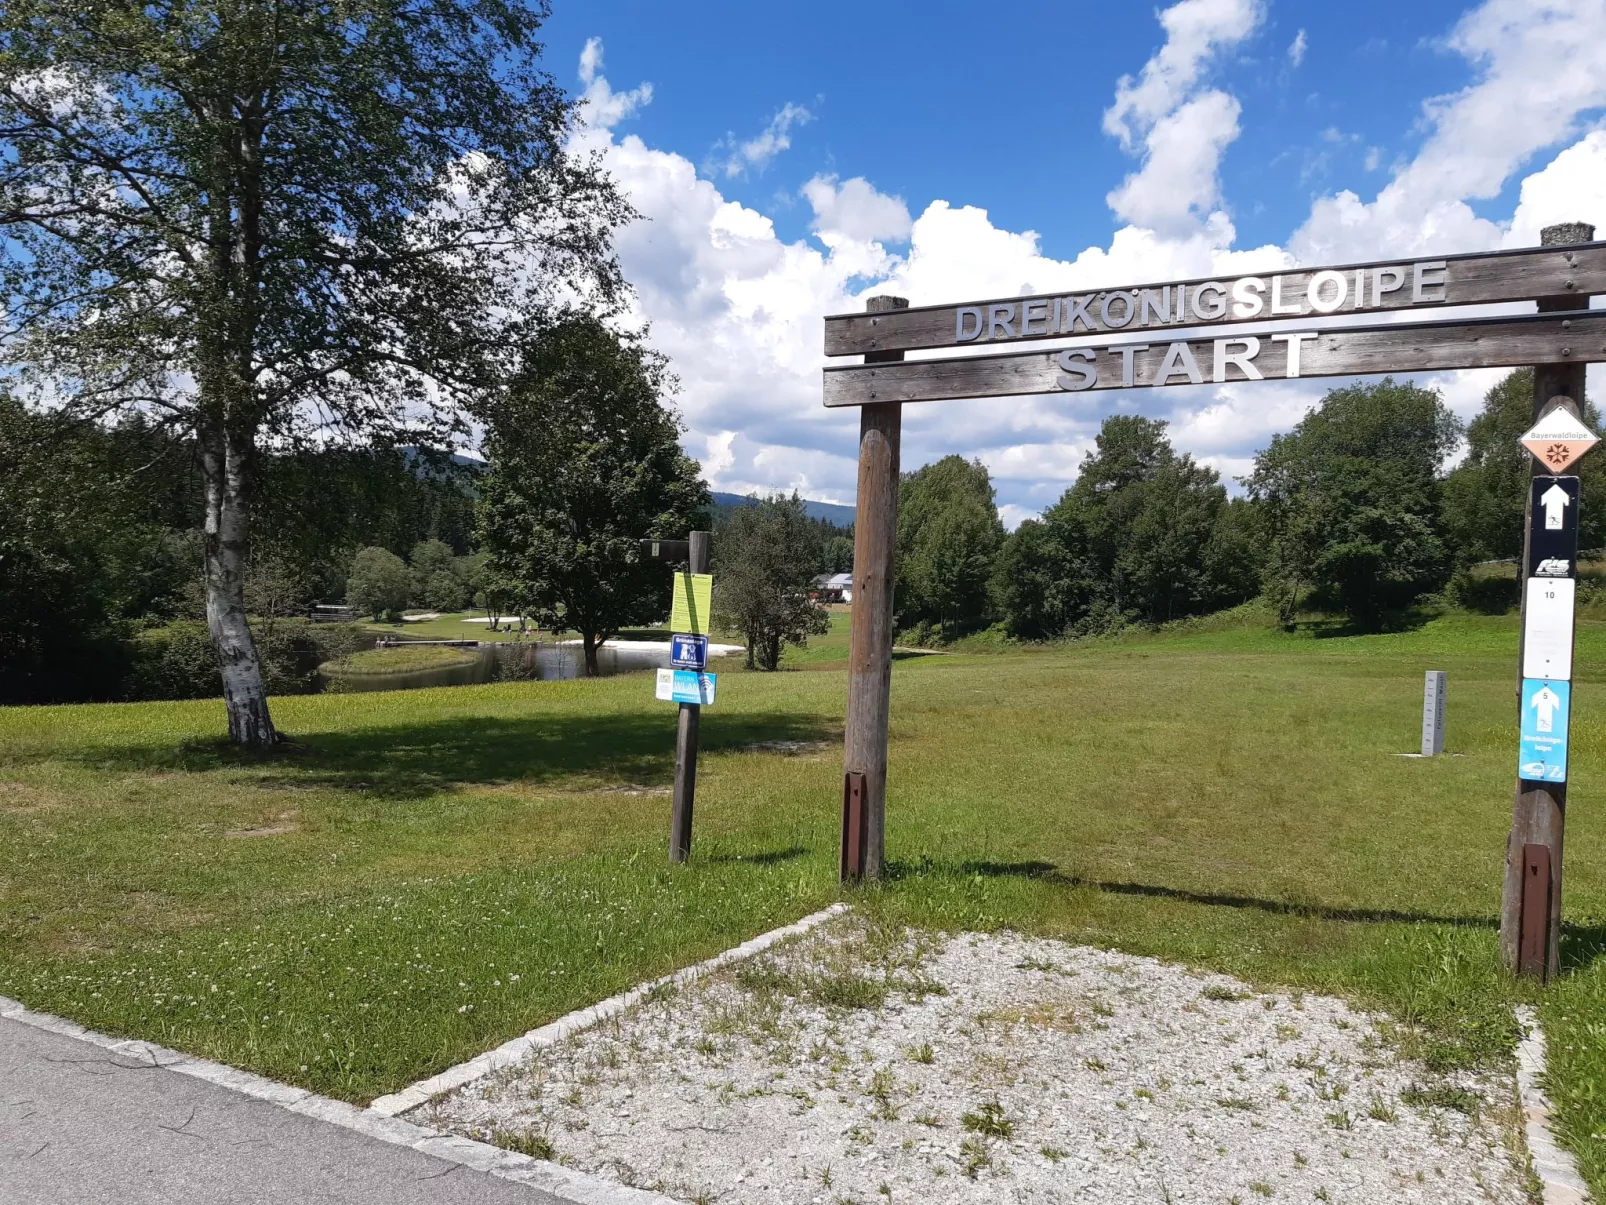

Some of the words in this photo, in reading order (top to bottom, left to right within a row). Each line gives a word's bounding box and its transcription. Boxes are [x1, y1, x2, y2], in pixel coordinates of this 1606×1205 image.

[955, 259, 1447, 343] DREIKÖNIGSLOIPE
[1056, 331, 1319, 391] START
[1530, 431, 1588, 440] Bayerwaldloipe
[1545, 591, 1555, 599] 10
[674, 682, 698, 692] WLAN
[1542, 692, 1548, 700] 5
